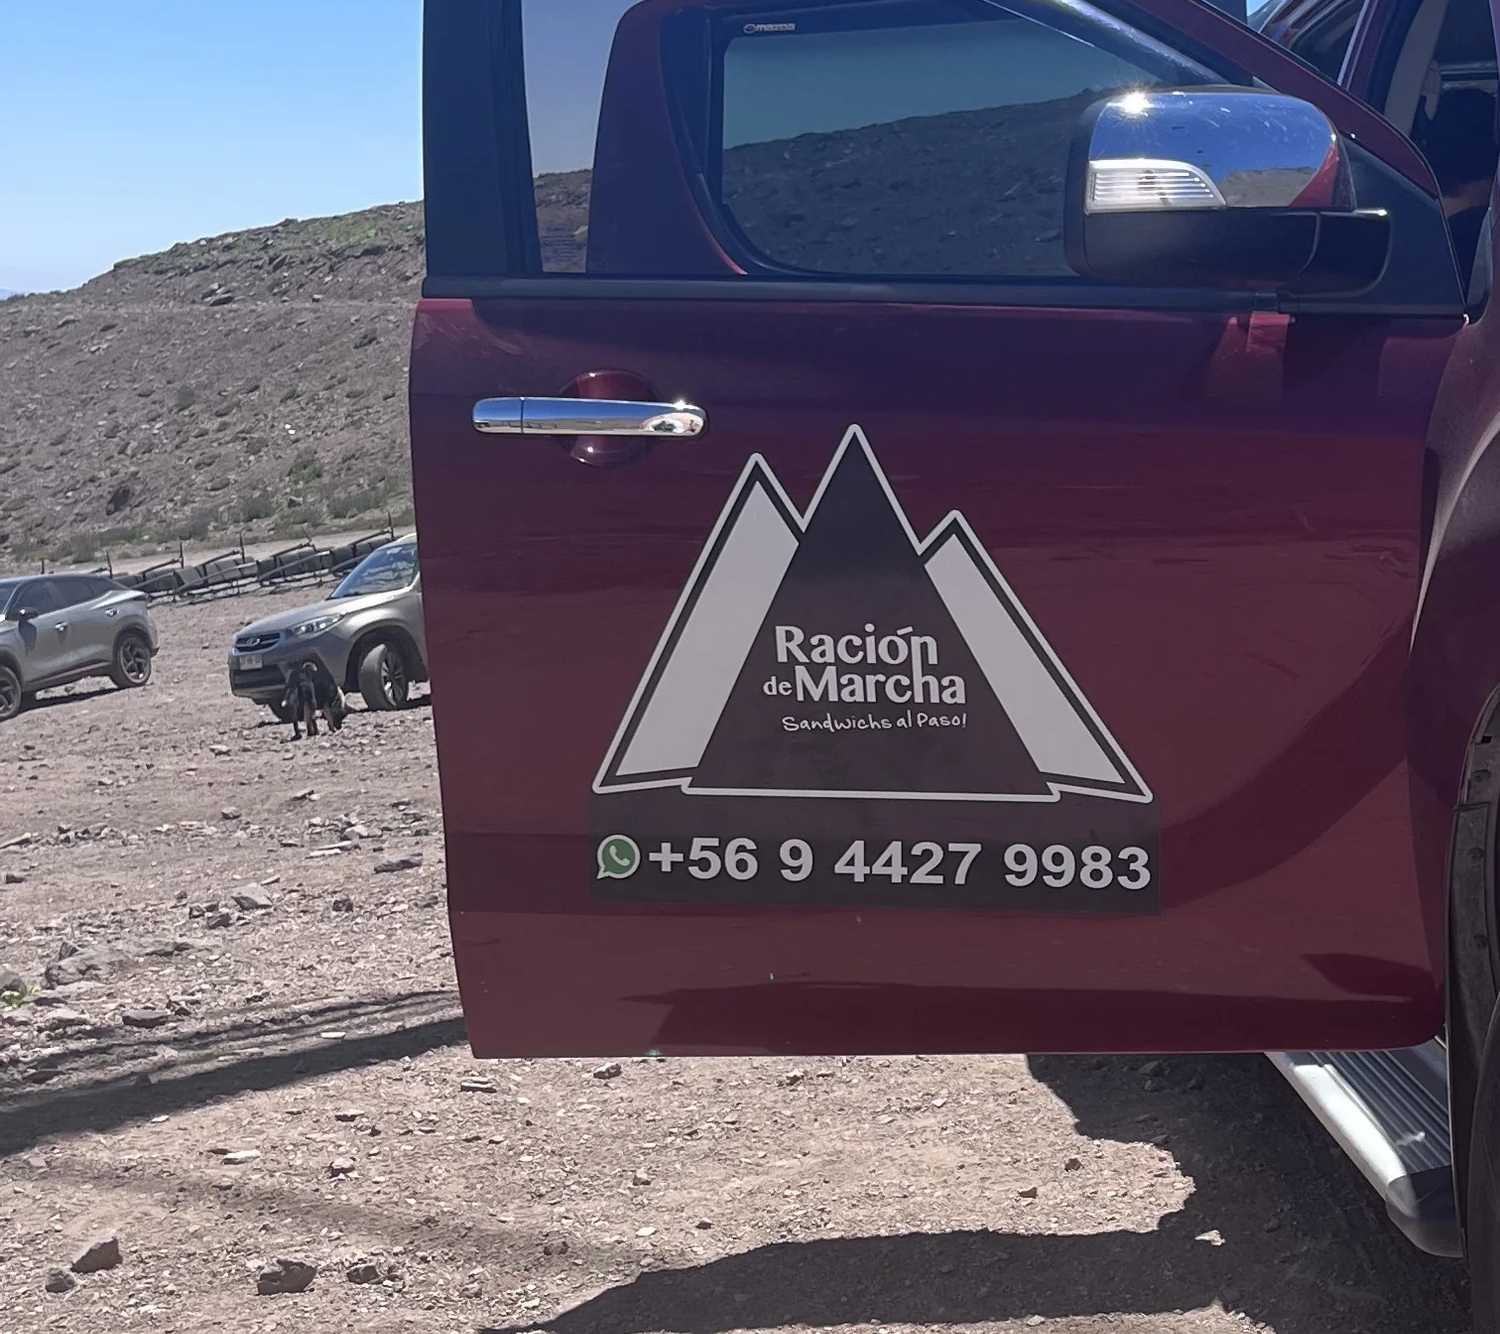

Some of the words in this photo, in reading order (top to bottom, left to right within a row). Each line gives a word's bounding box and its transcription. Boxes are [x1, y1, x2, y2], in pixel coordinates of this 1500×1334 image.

[775, 623, 938, 665] Ración
[763, 676, 793, 696] de
[795, 665, 966, 704] Marcha
[782, 713, 893, 732] Sandwichs
[896, 709, 913, 728] al
[916, 713, 967, 728] Paso!
[648, 837, 759, 880] +56
[779, 838, 814, 881] 9
[834, 840, 983, 885] 4427
[1003, 843, 1152, 890] 9983
